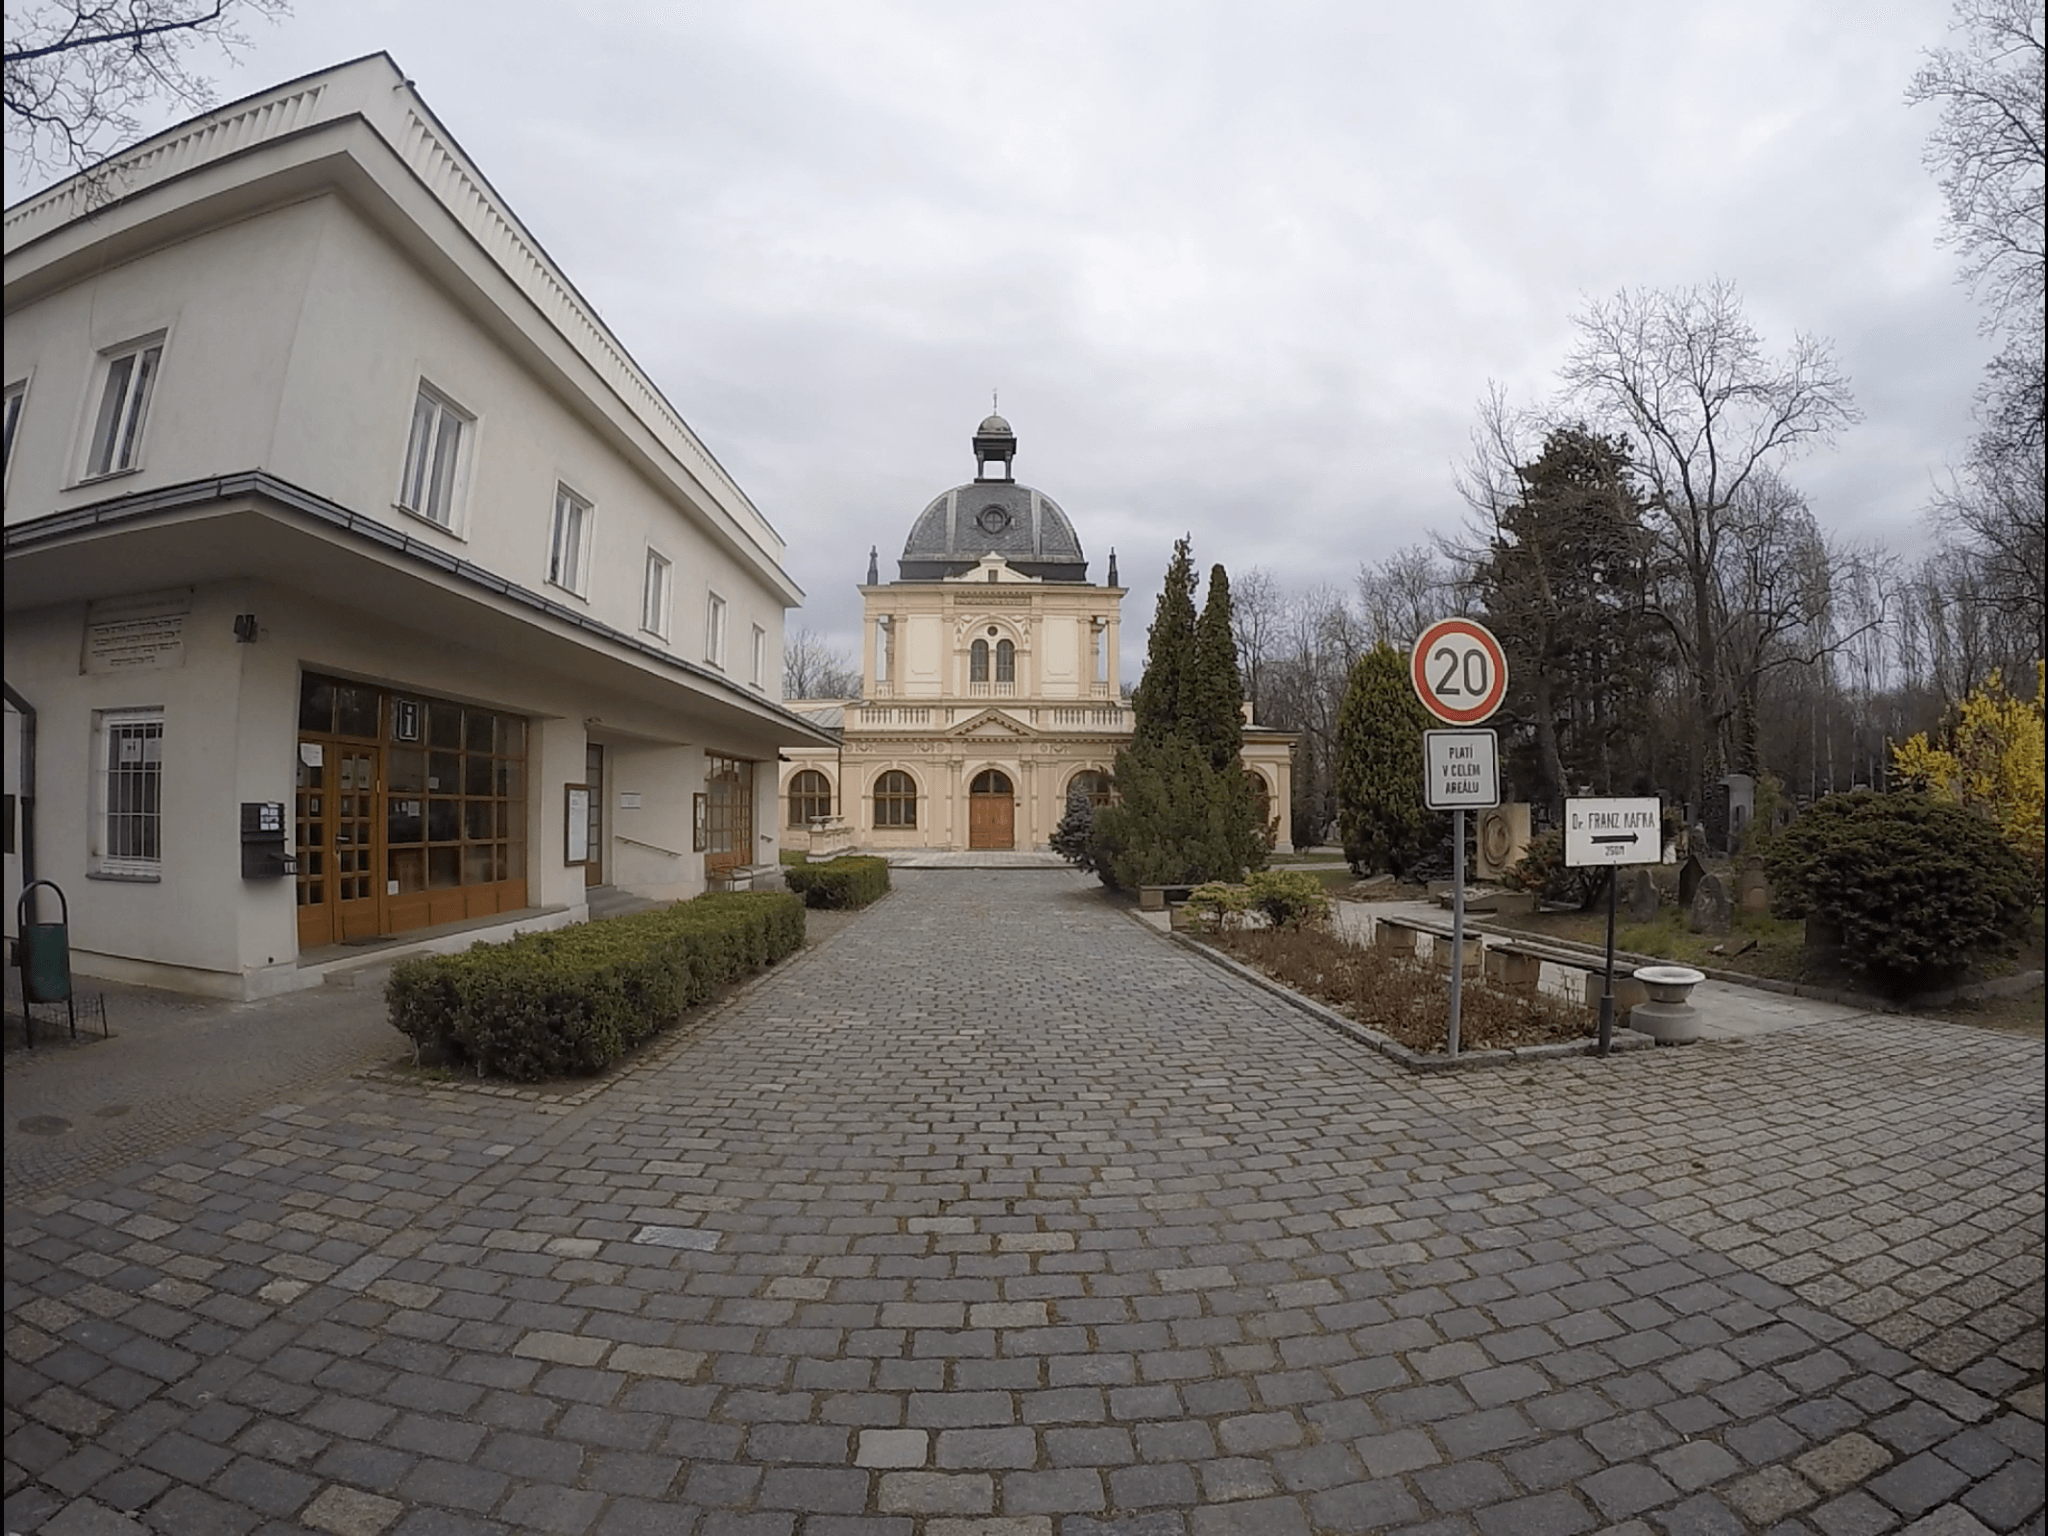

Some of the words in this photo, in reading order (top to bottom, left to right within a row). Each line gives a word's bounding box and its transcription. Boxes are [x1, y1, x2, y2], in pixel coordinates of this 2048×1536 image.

[1434, 647, 1488, 697] 20
[1449, 743, 1473, 759] PLATÍ
[1442, 764, 1448, 777] V
[1451, 762, 1481, 777] CELÉM
[1445, 779, 1479, 794] AREÁLU
[1588, 812, 1620, 830] FRANZ
[1624, 811, 1655, 828] KAFKA
